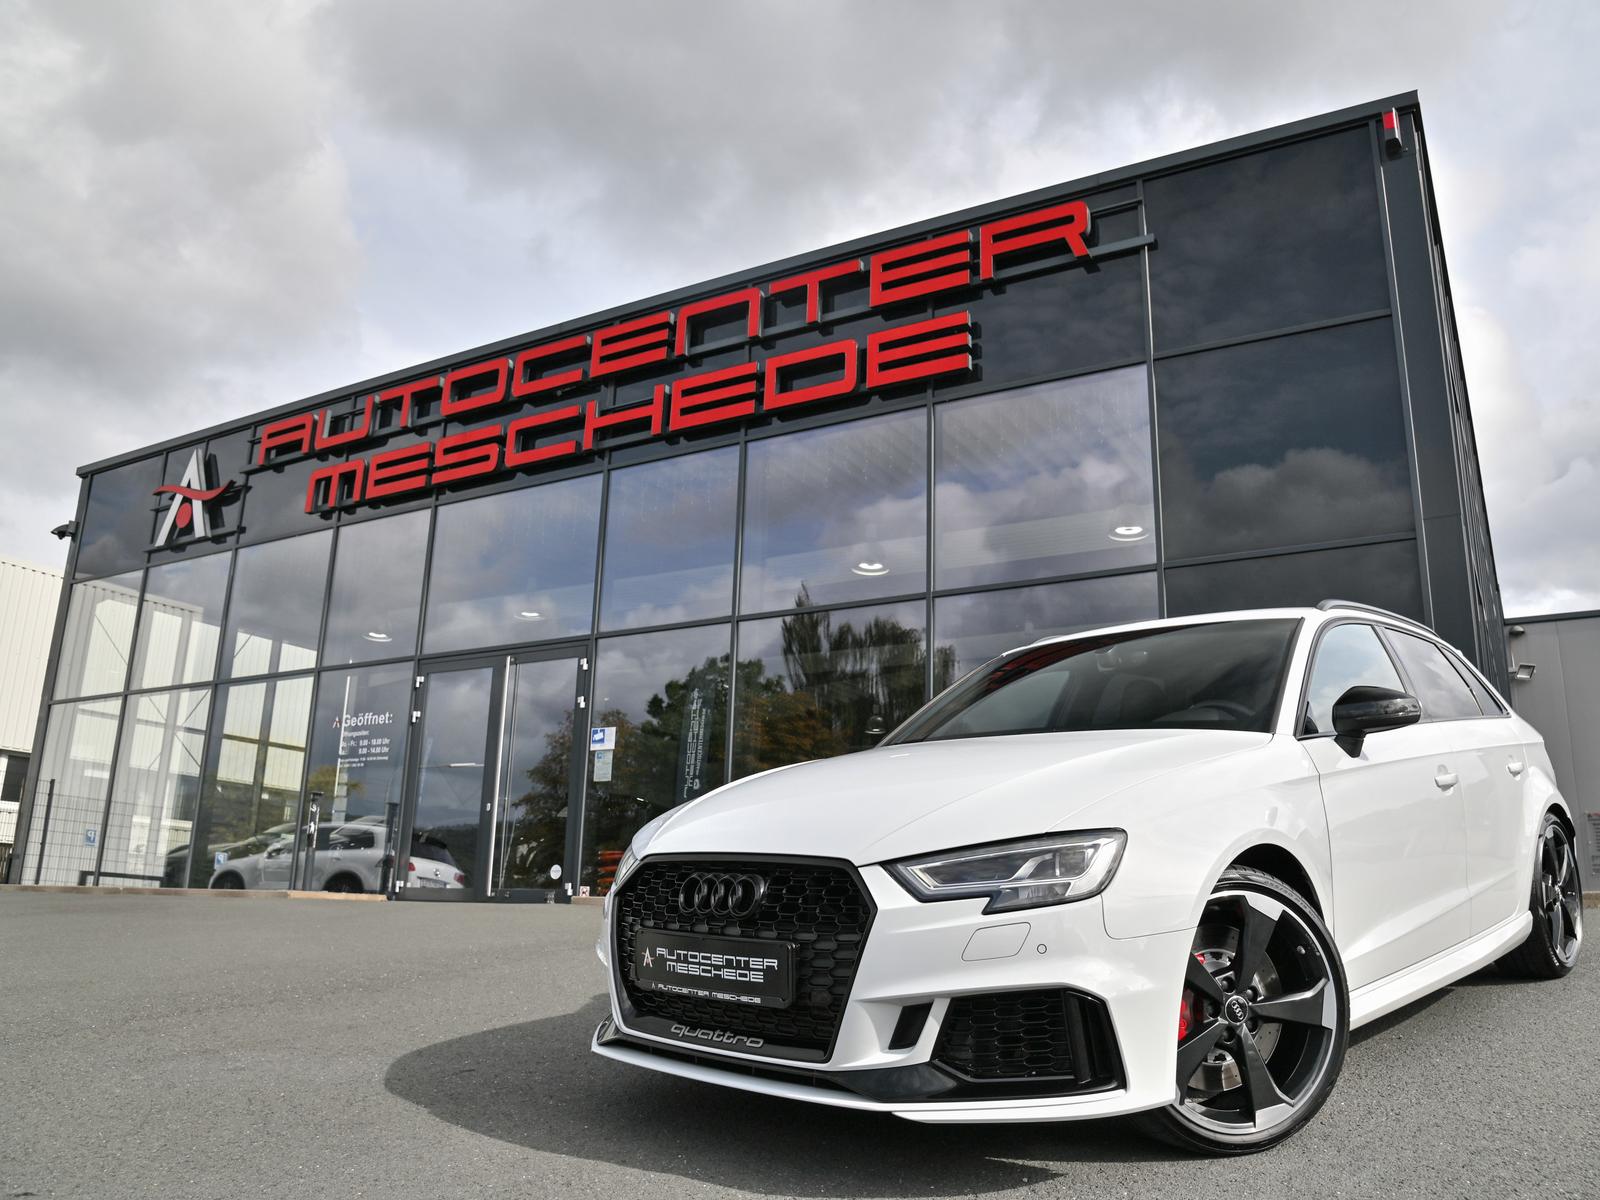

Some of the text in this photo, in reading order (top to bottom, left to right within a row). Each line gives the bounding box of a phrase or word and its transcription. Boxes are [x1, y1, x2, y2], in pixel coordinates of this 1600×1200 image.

[257, 200, 1092, 466] AUTOCENTER
[304, 311, 974, 513] MESCHEDE
[342, 711, 393, 727] Geöffnet:
[656, 947, 778, 970] AUTOCENTER
[666, 961, 764, 983] MESCHEDE
[657, 983, 709, 998] AUTOCENTER
[711, 992, 761, 1004] MESCHEDE
[670, 1023, 764, 1048] quattro
